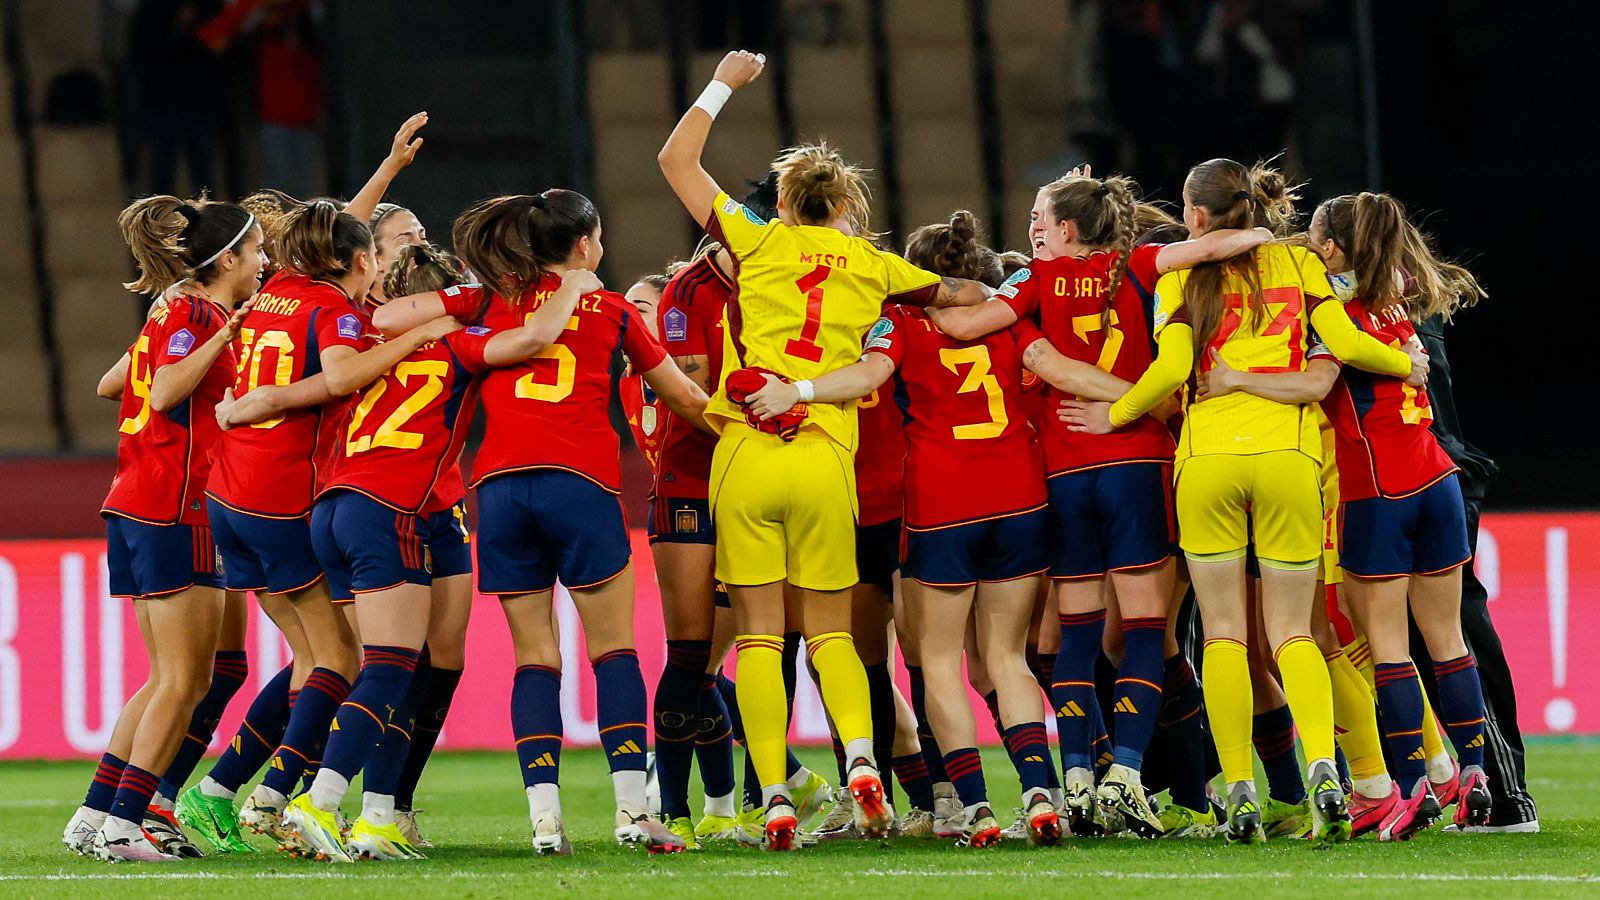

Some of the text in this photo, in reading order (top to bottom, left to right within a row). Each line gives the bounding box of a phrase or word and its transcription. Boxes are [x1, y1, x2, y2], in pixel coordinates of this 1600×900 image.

[514, 312, 580, 403] 5
[784, 264, 831, 363] 1
[1200, 286, 1304, 374] 23
[345, 359, 450, 458] 22
[938, 344, 1009, 440] 3
